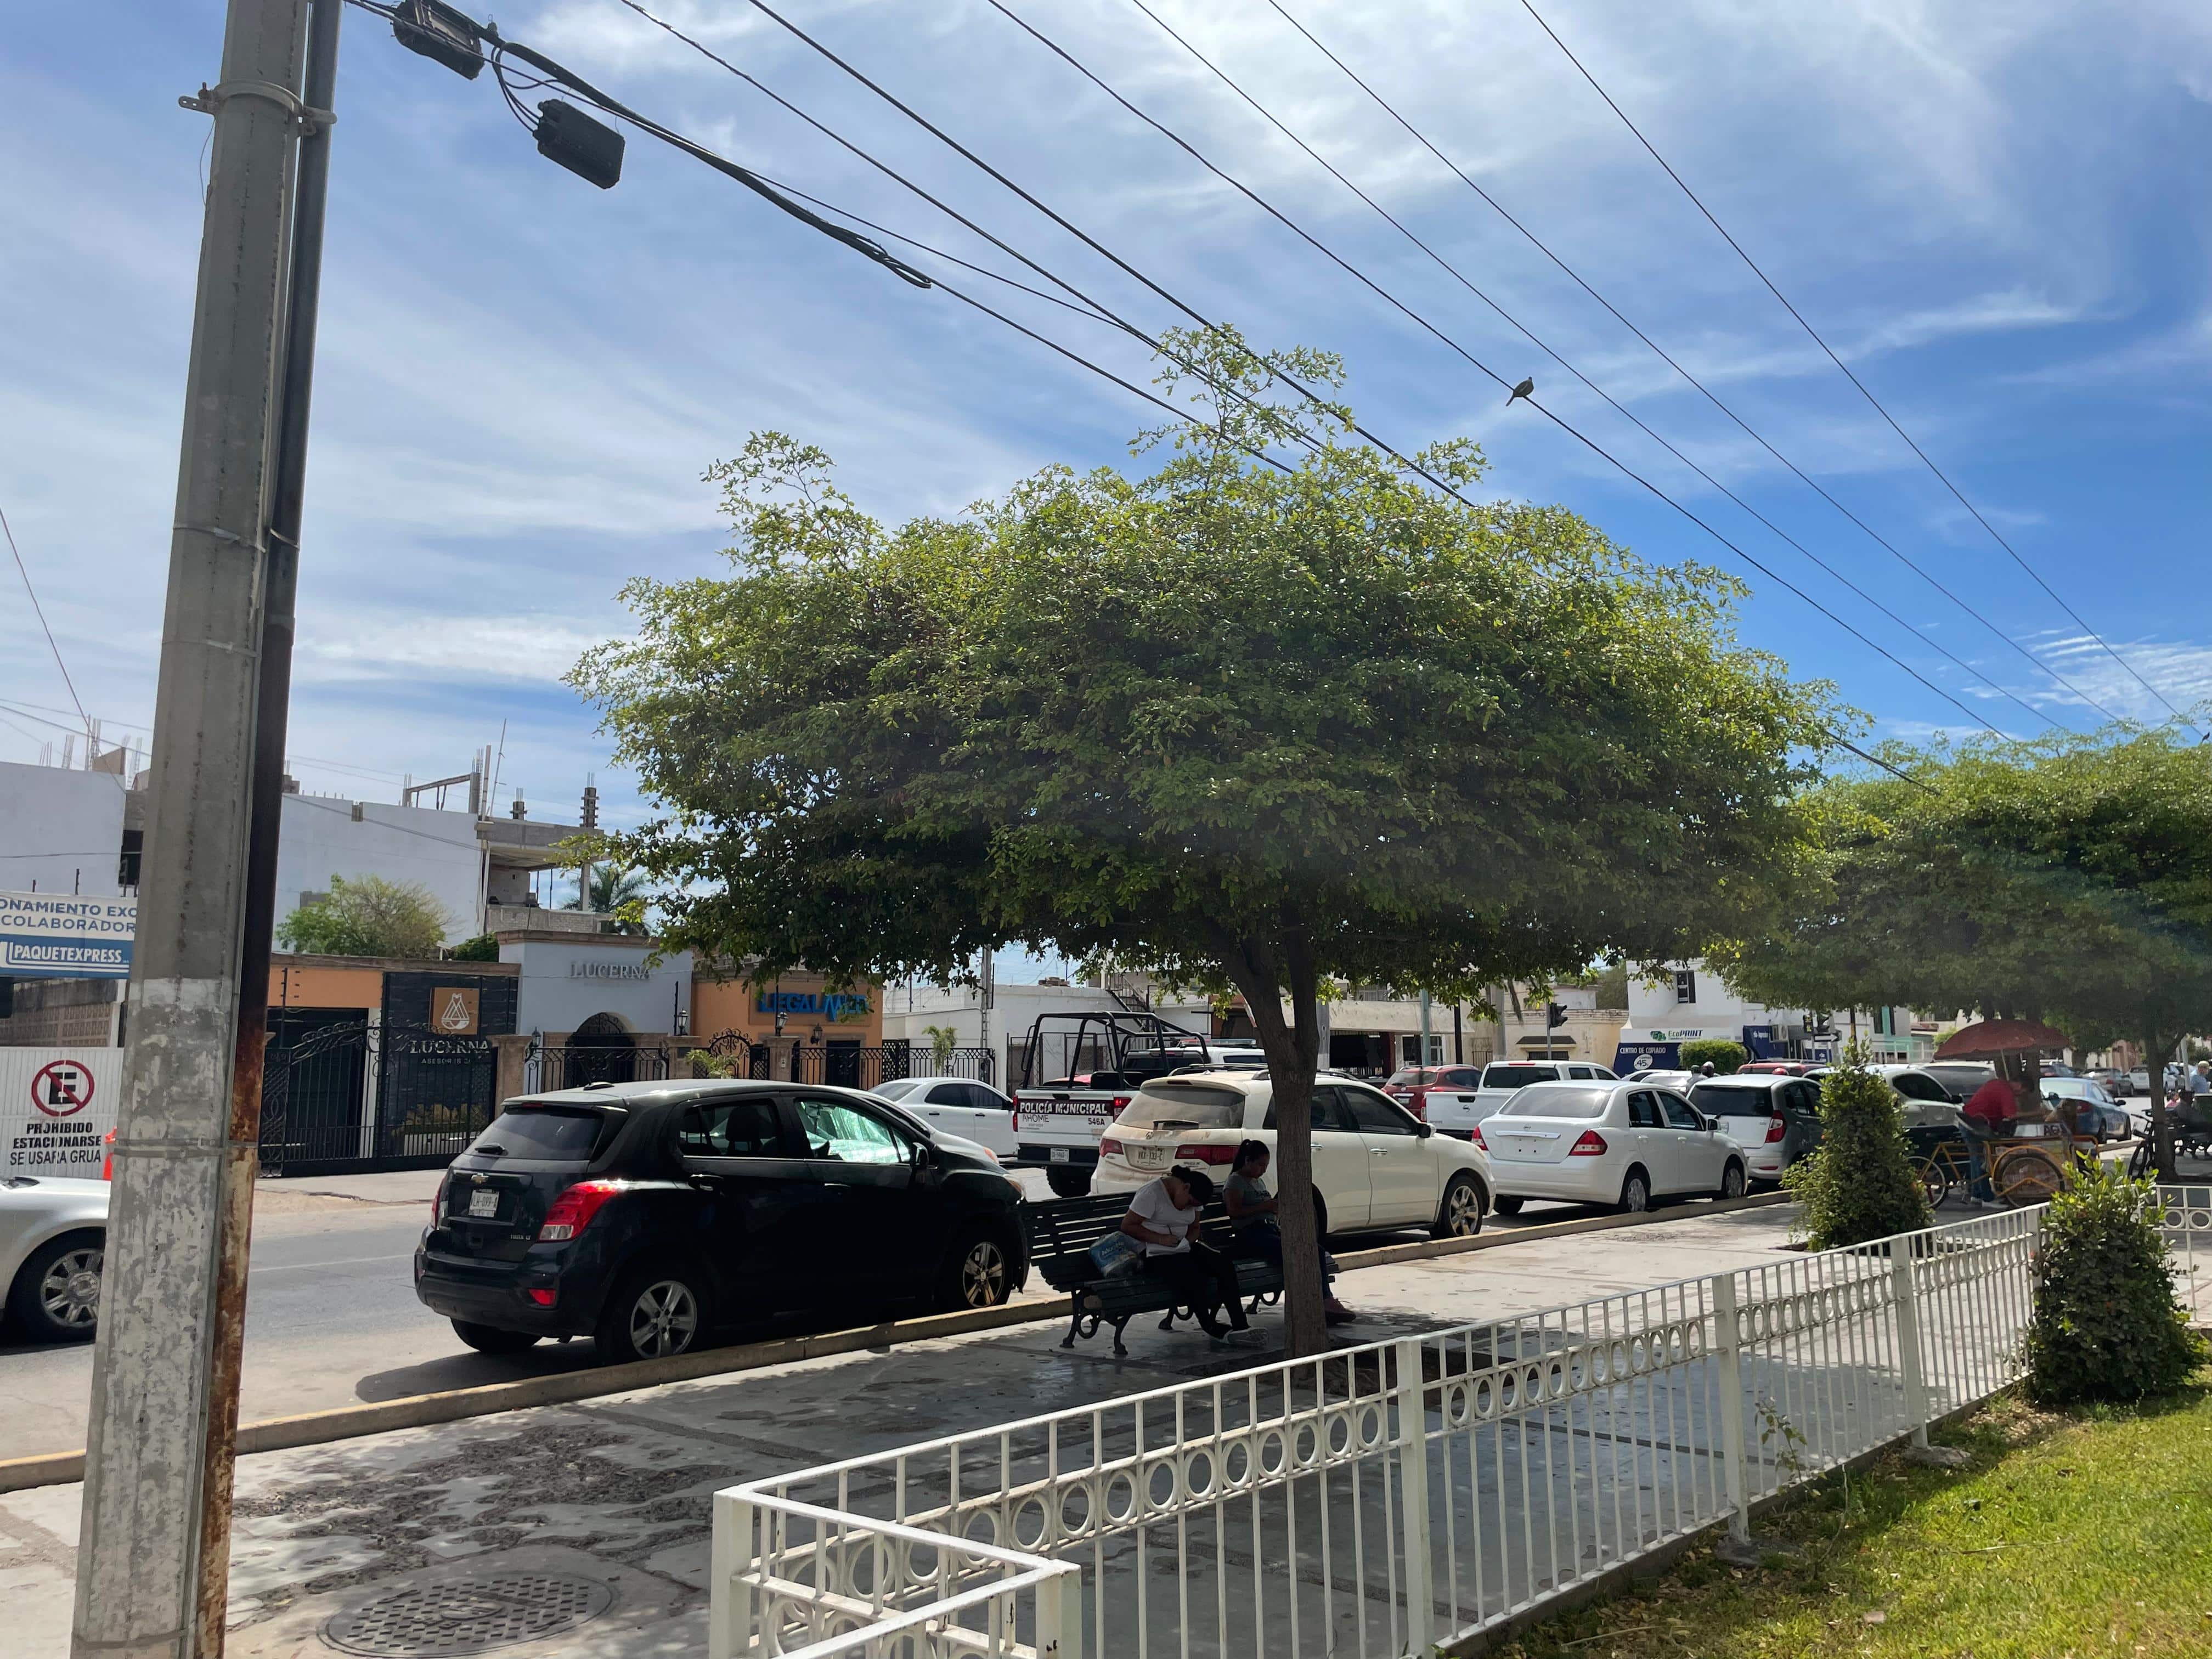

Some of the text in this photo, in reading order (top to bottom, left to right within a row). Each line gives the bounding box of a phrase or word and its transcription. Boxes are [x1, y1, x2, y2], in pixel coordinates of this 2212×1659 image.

[14, 944, 122, 963] PAQUETEXPRESS
[571, 963, 650, 979] LUCERNA
[1020, 1101, 1108, 1114] POLICÍA MUNICIPAL
[1023, 1114, 1049, 1122] AHOME
[26, 1122, 93, 1134] PROHIBIDO
[13, 1136, 101, 1149] ESTACIONARSE
[10, 1149, 101, 1166] SE USARA GRUA
